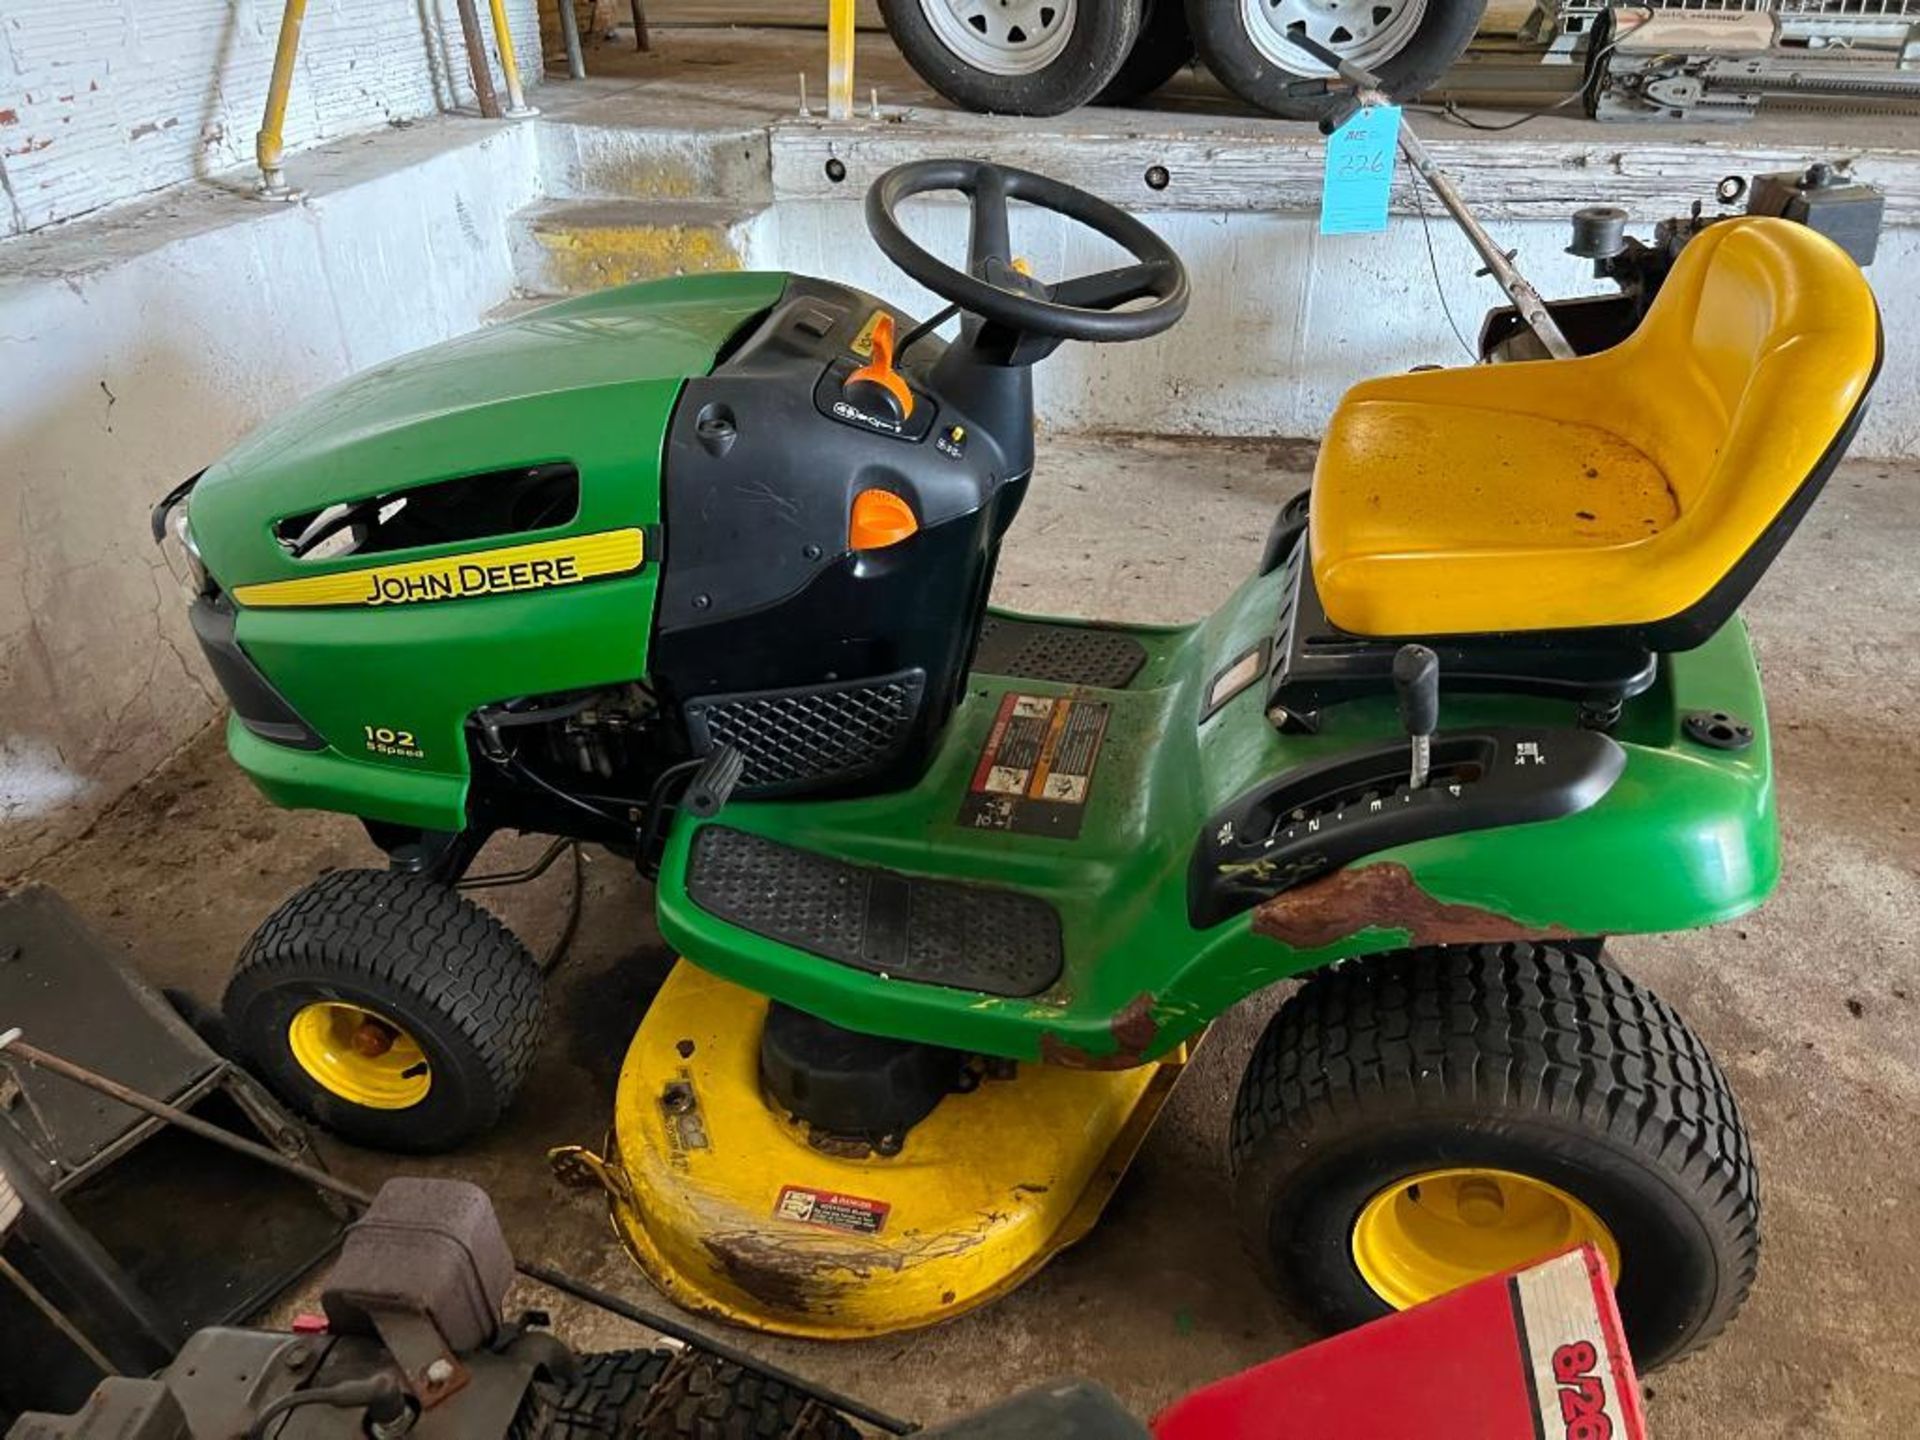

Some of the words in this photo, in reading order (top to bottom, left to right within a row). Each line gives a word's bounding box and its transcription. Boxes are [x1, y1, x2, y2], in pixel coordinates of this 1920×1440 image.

[1340, 149, 1385, 175] 226
[367, 572, 453, 601] JOHN
[458, 556, 579, 593] DEERE
[365, 726, 414, 746] 102
